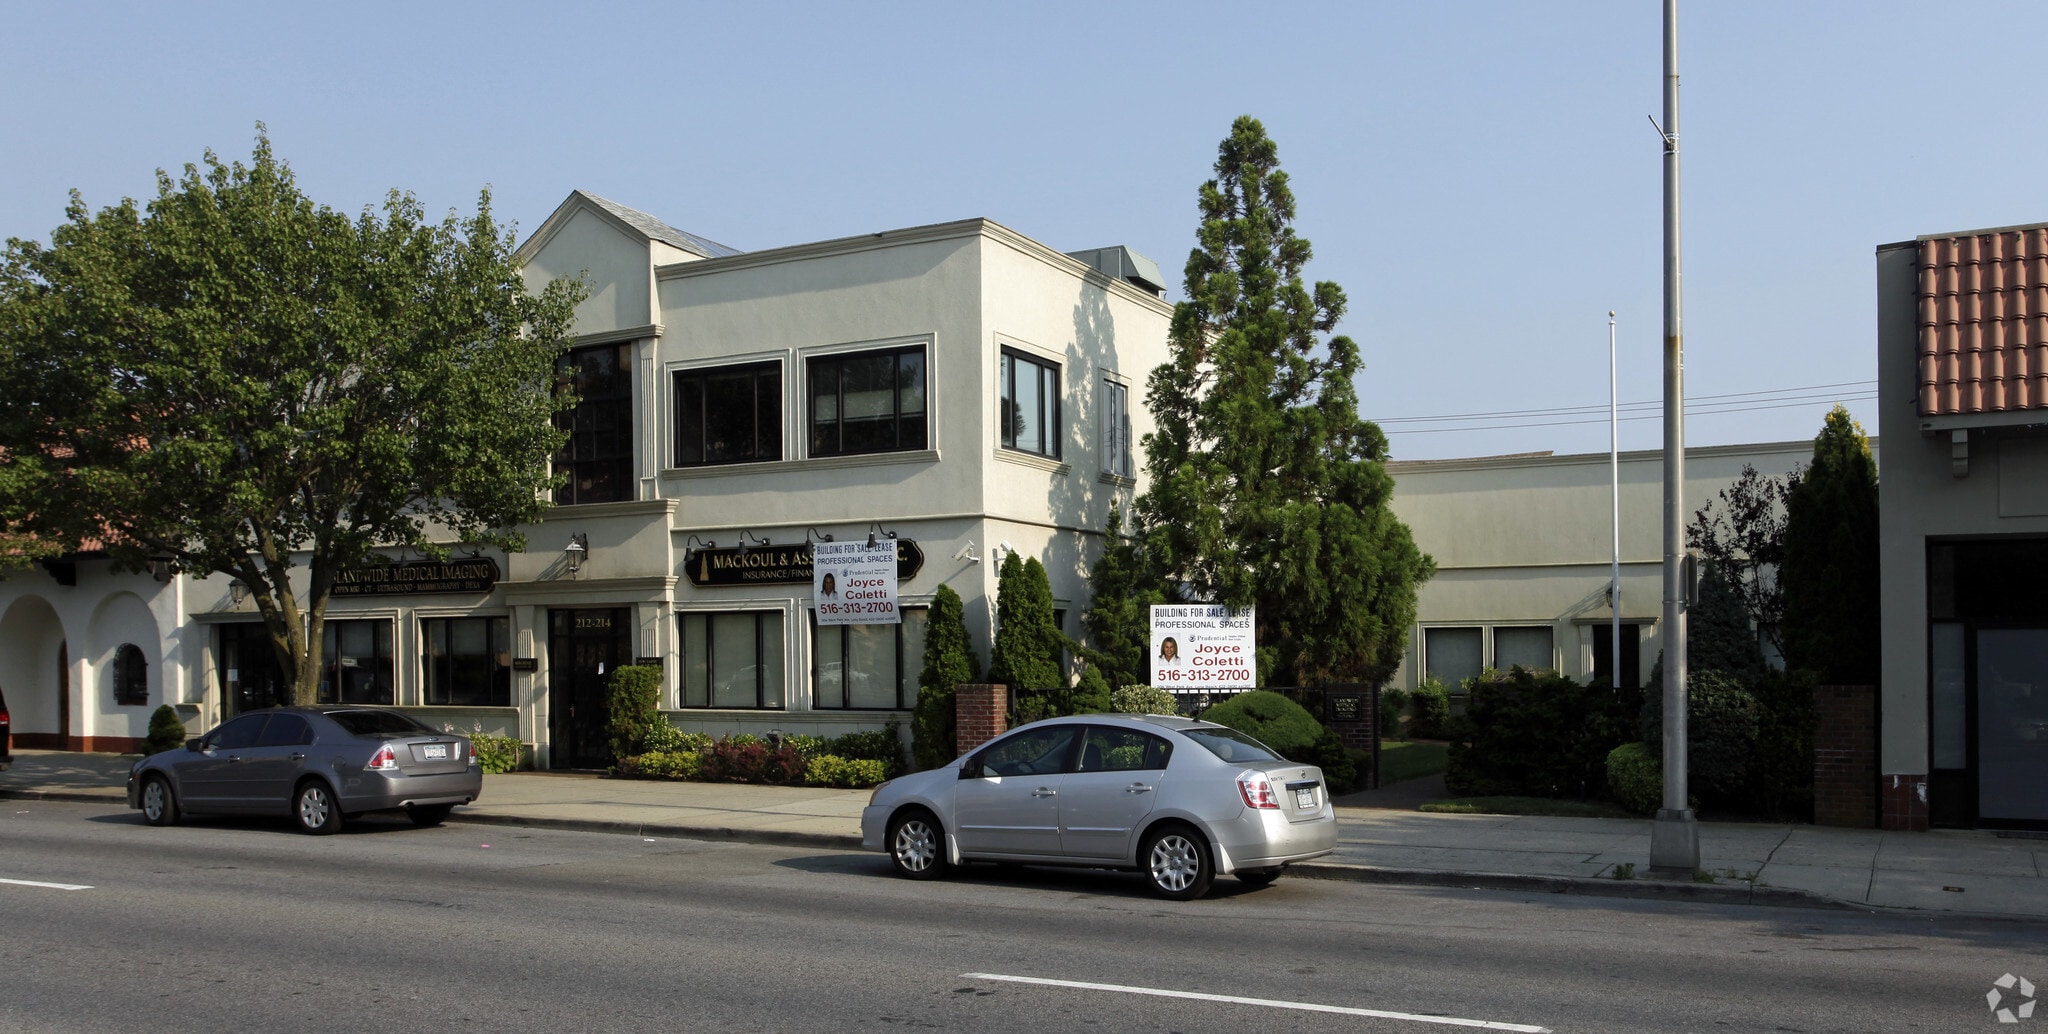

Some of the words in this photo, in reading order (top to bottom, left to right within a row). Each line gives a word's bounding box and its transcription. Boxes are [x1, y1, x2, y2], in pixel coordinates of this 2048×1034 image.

[817, 545, 842, 555] BUILDING
[844, 544, 855, 554] FOR
[874, 542, 892, 552] LEASE
[714, 552, 776, 569] MACKOUL
[780, 552, 788, 566] &
[817, 556, 865, 565] PROFESSIONAL
[867, 554, 893, 563] SPACES
[393, 565, 439, 582] MEDICAL
[442, 563, 489, 580] IMAGING
[377, 583, 413, 592] ULTRASOUND
[847, 578, 885, 589] Joyce
[845, 589, 887, 600] Coletti
[820, 601, 893, 615] 516-313-2700
[1155, 608, 1188, 617] BUILDING
[1190, 608, 1204, 617] FOR
[1206, 607, 1224, 617] SALE
[575, 618, 611, 628] 212-214
[1155, 620, 1216, 629] PROFESSIONAL
[1219, 620, 1250, 629] SPACES
[1194, 643, 1241, 655] Joyce
[1192, 656, 1244, 666] Coletti
[1158, 669, 1250, 681] 516-313-2700
